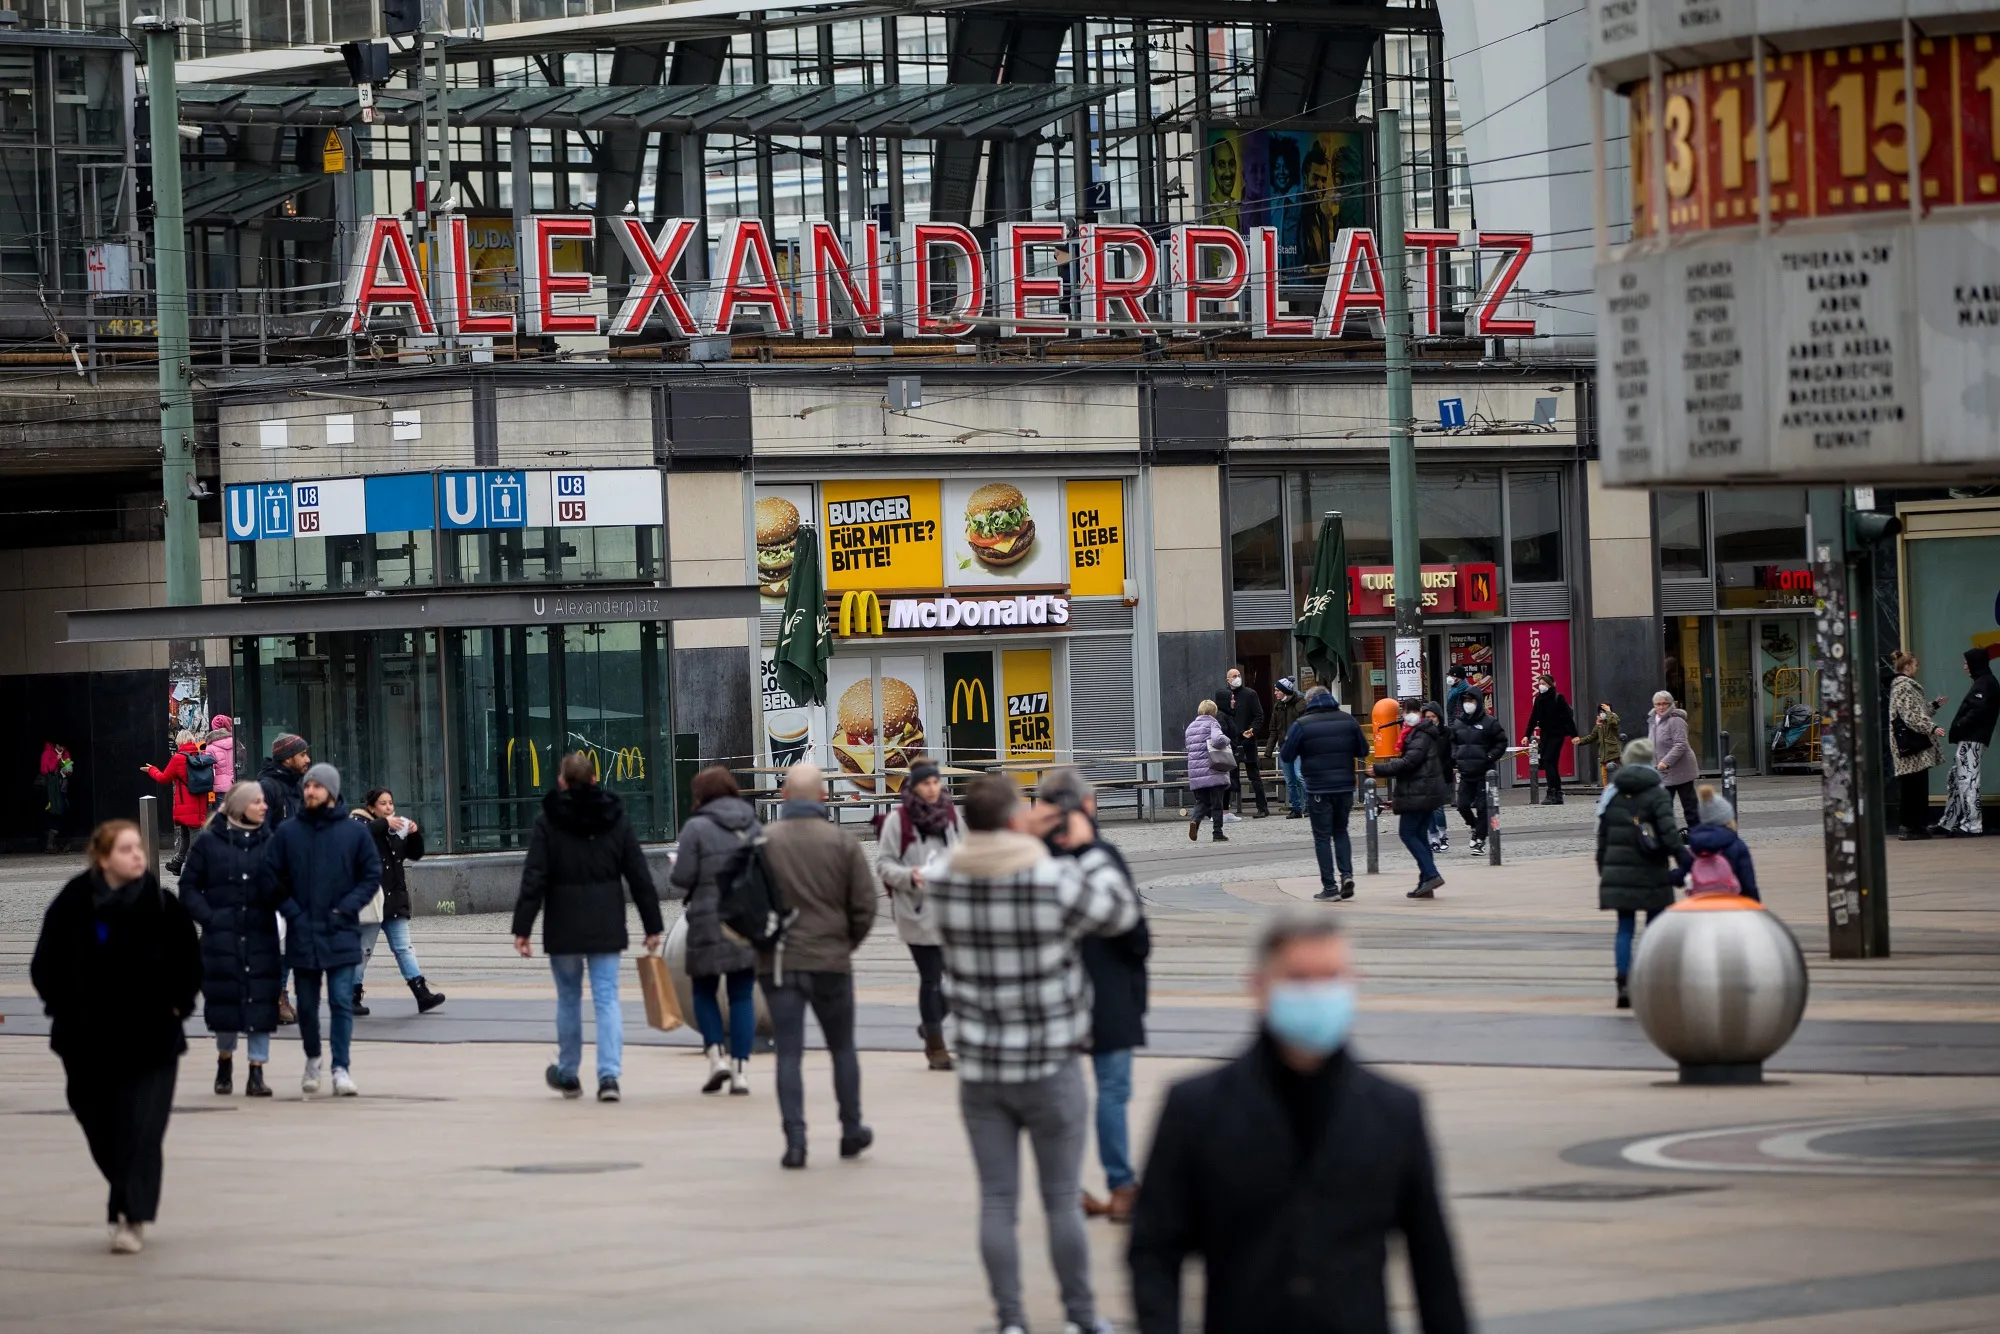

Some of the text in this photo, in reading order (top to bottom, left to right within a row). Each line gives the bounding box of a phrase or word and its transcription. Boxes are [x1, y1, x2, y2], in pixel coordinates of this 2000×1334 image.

[1827, 67, 1932, 177] 15
[1713, 81, 1790, 189] 14
[1095, 182, 1107, 204] 2
[344, 213, 1537, 340] ALEXANDERPLATZ
[1819, 295, 1861, 313] ADEN
[1954, 284, 2000, 305] KABU
[1810, 317, 1868, 337] SANAA
[1443, 401, 1457, 424] T
[299, 488, 317, 505] U8
[560, 477, 583, 495] U8
[446, 476, 477, 525] U
[561, 503, 584, 520] U5
[828, 497, 910, 526] BURGER
[231, 489, 255, 537] U
[300, 513, 318, 530] U5
[1072, 509, 1099, 529] ICH
[869, 520, 936, 546] MITTE?
[1073, 527, 1118, 547] LIEBE
[831, 547, 891, 572] BITTE!
[1766, 565, 1815, 595] Kam
[533, 596, 659, 617] U Alexanderplatz
[887, 595, 1069, 629] McDonald's
[1009, 693, 1048, 716] 24/7
[1010, 743, 1034, 755] DICH
